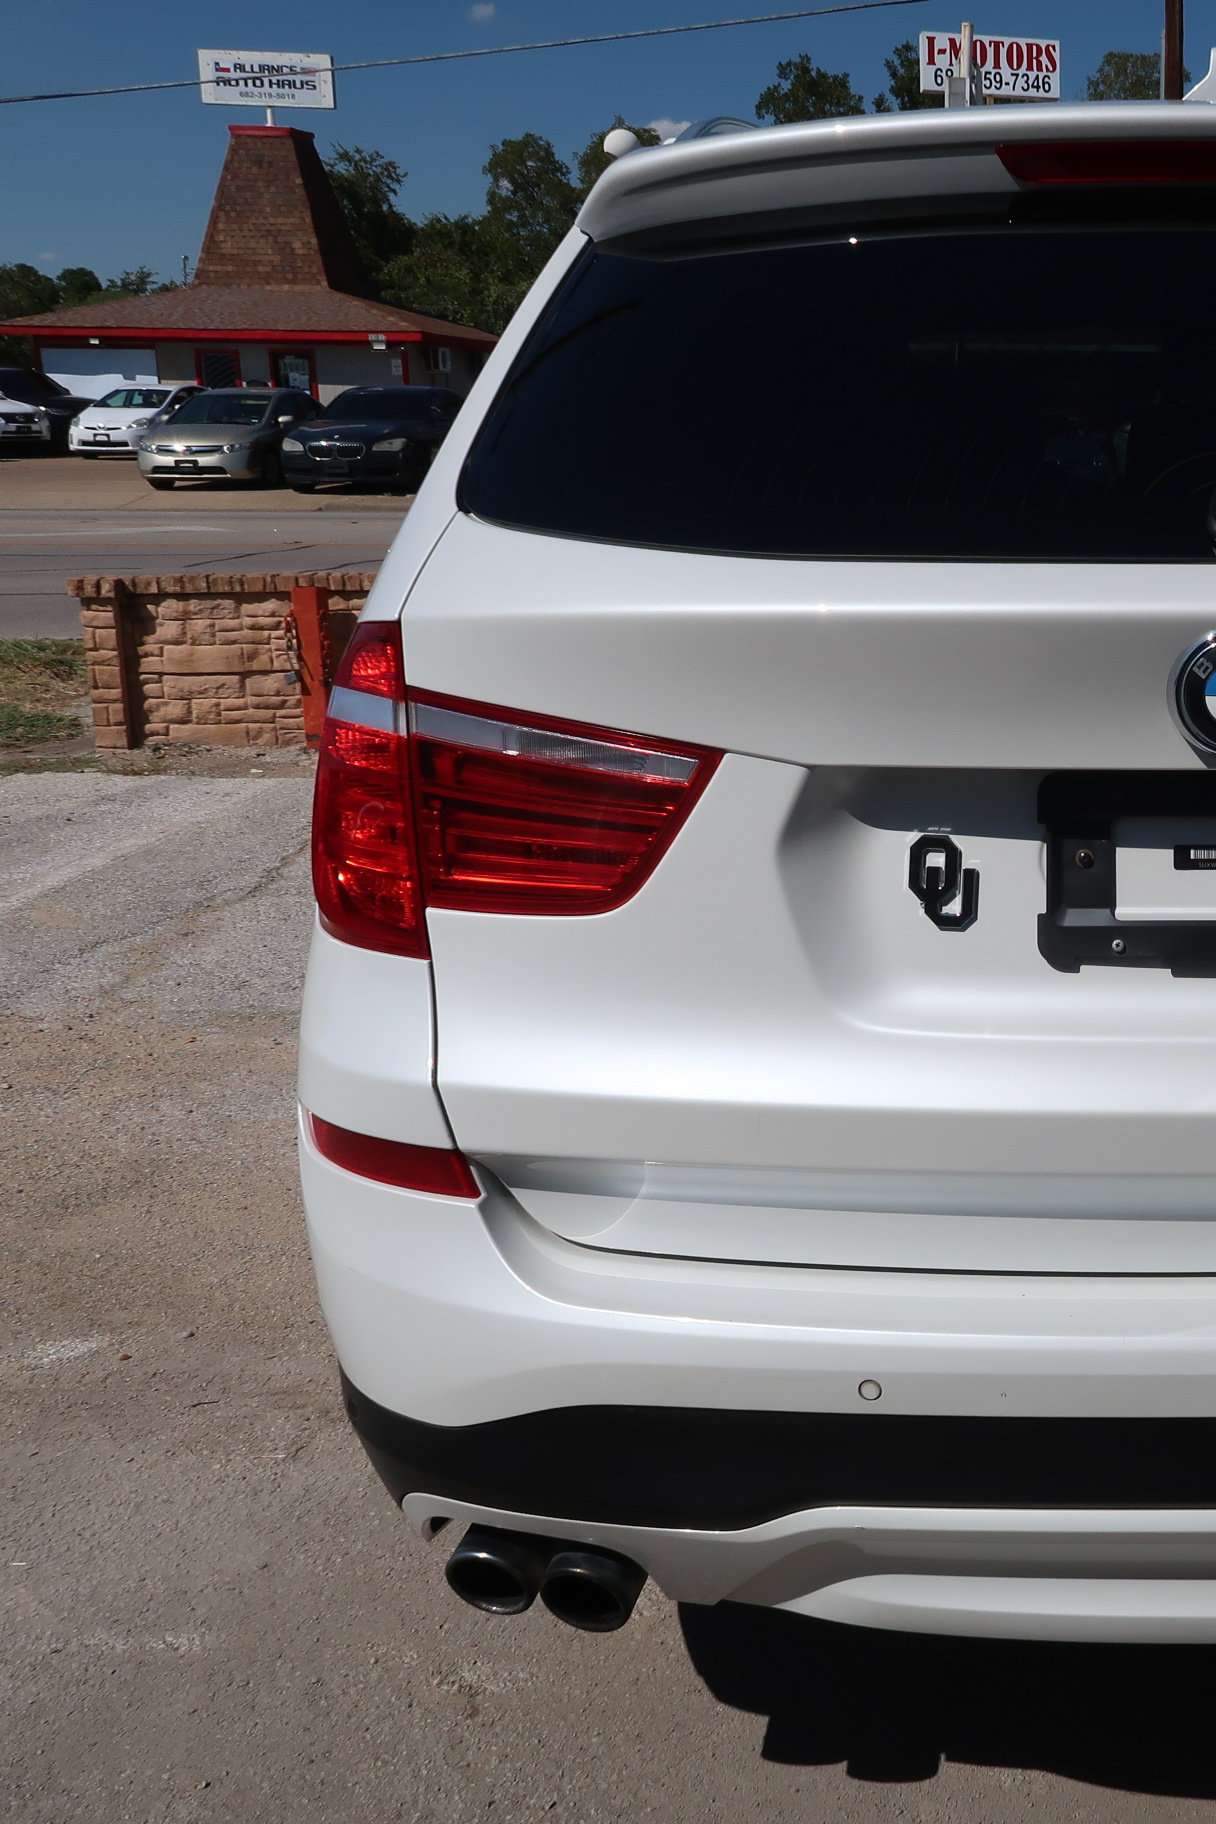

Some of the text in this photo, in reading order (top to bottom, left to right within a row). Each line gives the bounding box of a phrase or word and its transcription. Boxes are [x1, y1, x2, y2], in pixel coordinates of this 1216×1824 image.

[233, 62, 297, 75] ALLIANCE
[215, 76, 317, 91] AUTO HAUS
